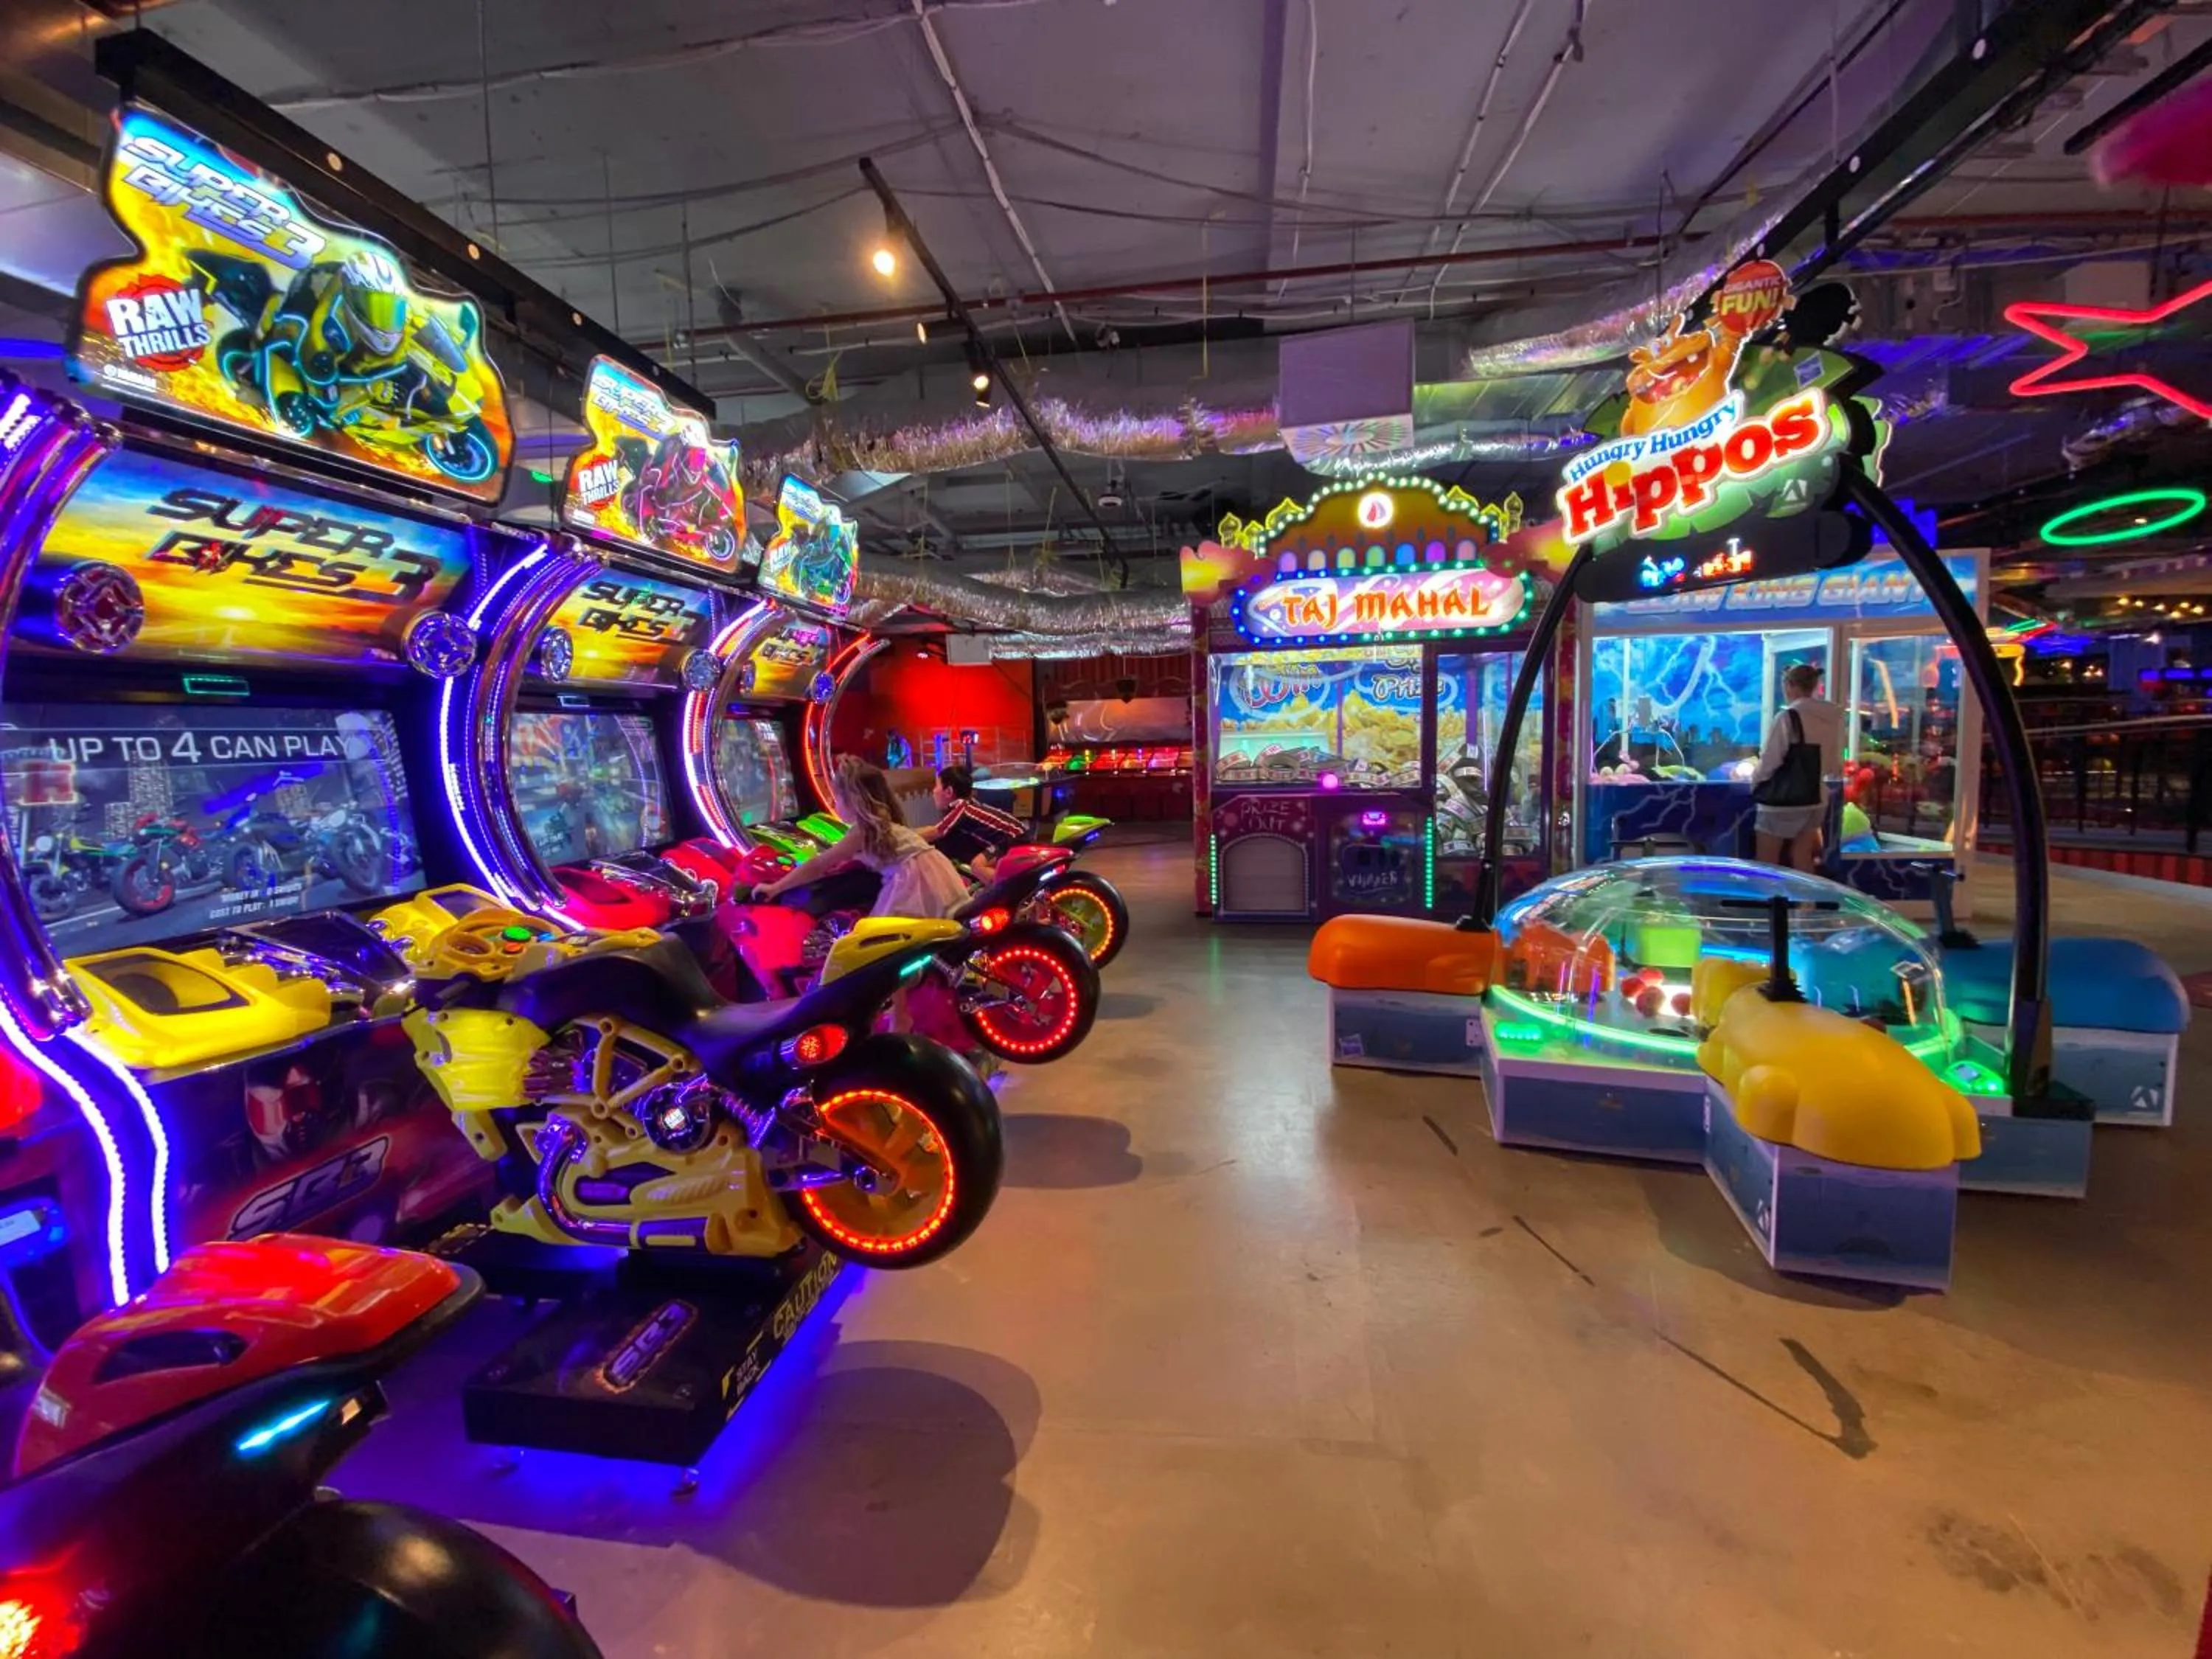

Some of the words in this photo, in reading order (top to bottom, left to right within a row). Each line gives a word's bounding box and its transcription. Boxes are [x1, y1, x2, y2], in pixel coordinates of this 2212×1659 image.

[120, 136, 292, 227] SUPER
[105, 289, 204, 336] RAW
[117, 324, 212, 359] THRILLS
[1569, 439, 1646, 482] Hungry
[1650, 398, 1736, 455] Hungry
[578, 459, 619, 494] RAW
[145, 487, 395, 559] SUPER
[1282, 593, 1338, 628] TAJ
[1354, 584, 1490, 622] MAHAL
[1725, 573, 1820, 610] KING
[1371, 674, 1444, 700] Priz
[49, 737, 104, 762] UP
[112, 737, 161, 762] TO
[171, 731, 202, 763] 4
[210, 736, 275, 759] CAN
[283, 734, 352, 758] PLAY
[1241, 801, 1290, 819] PRIZE
[773, 1250, 838, 1340] CAUTION
